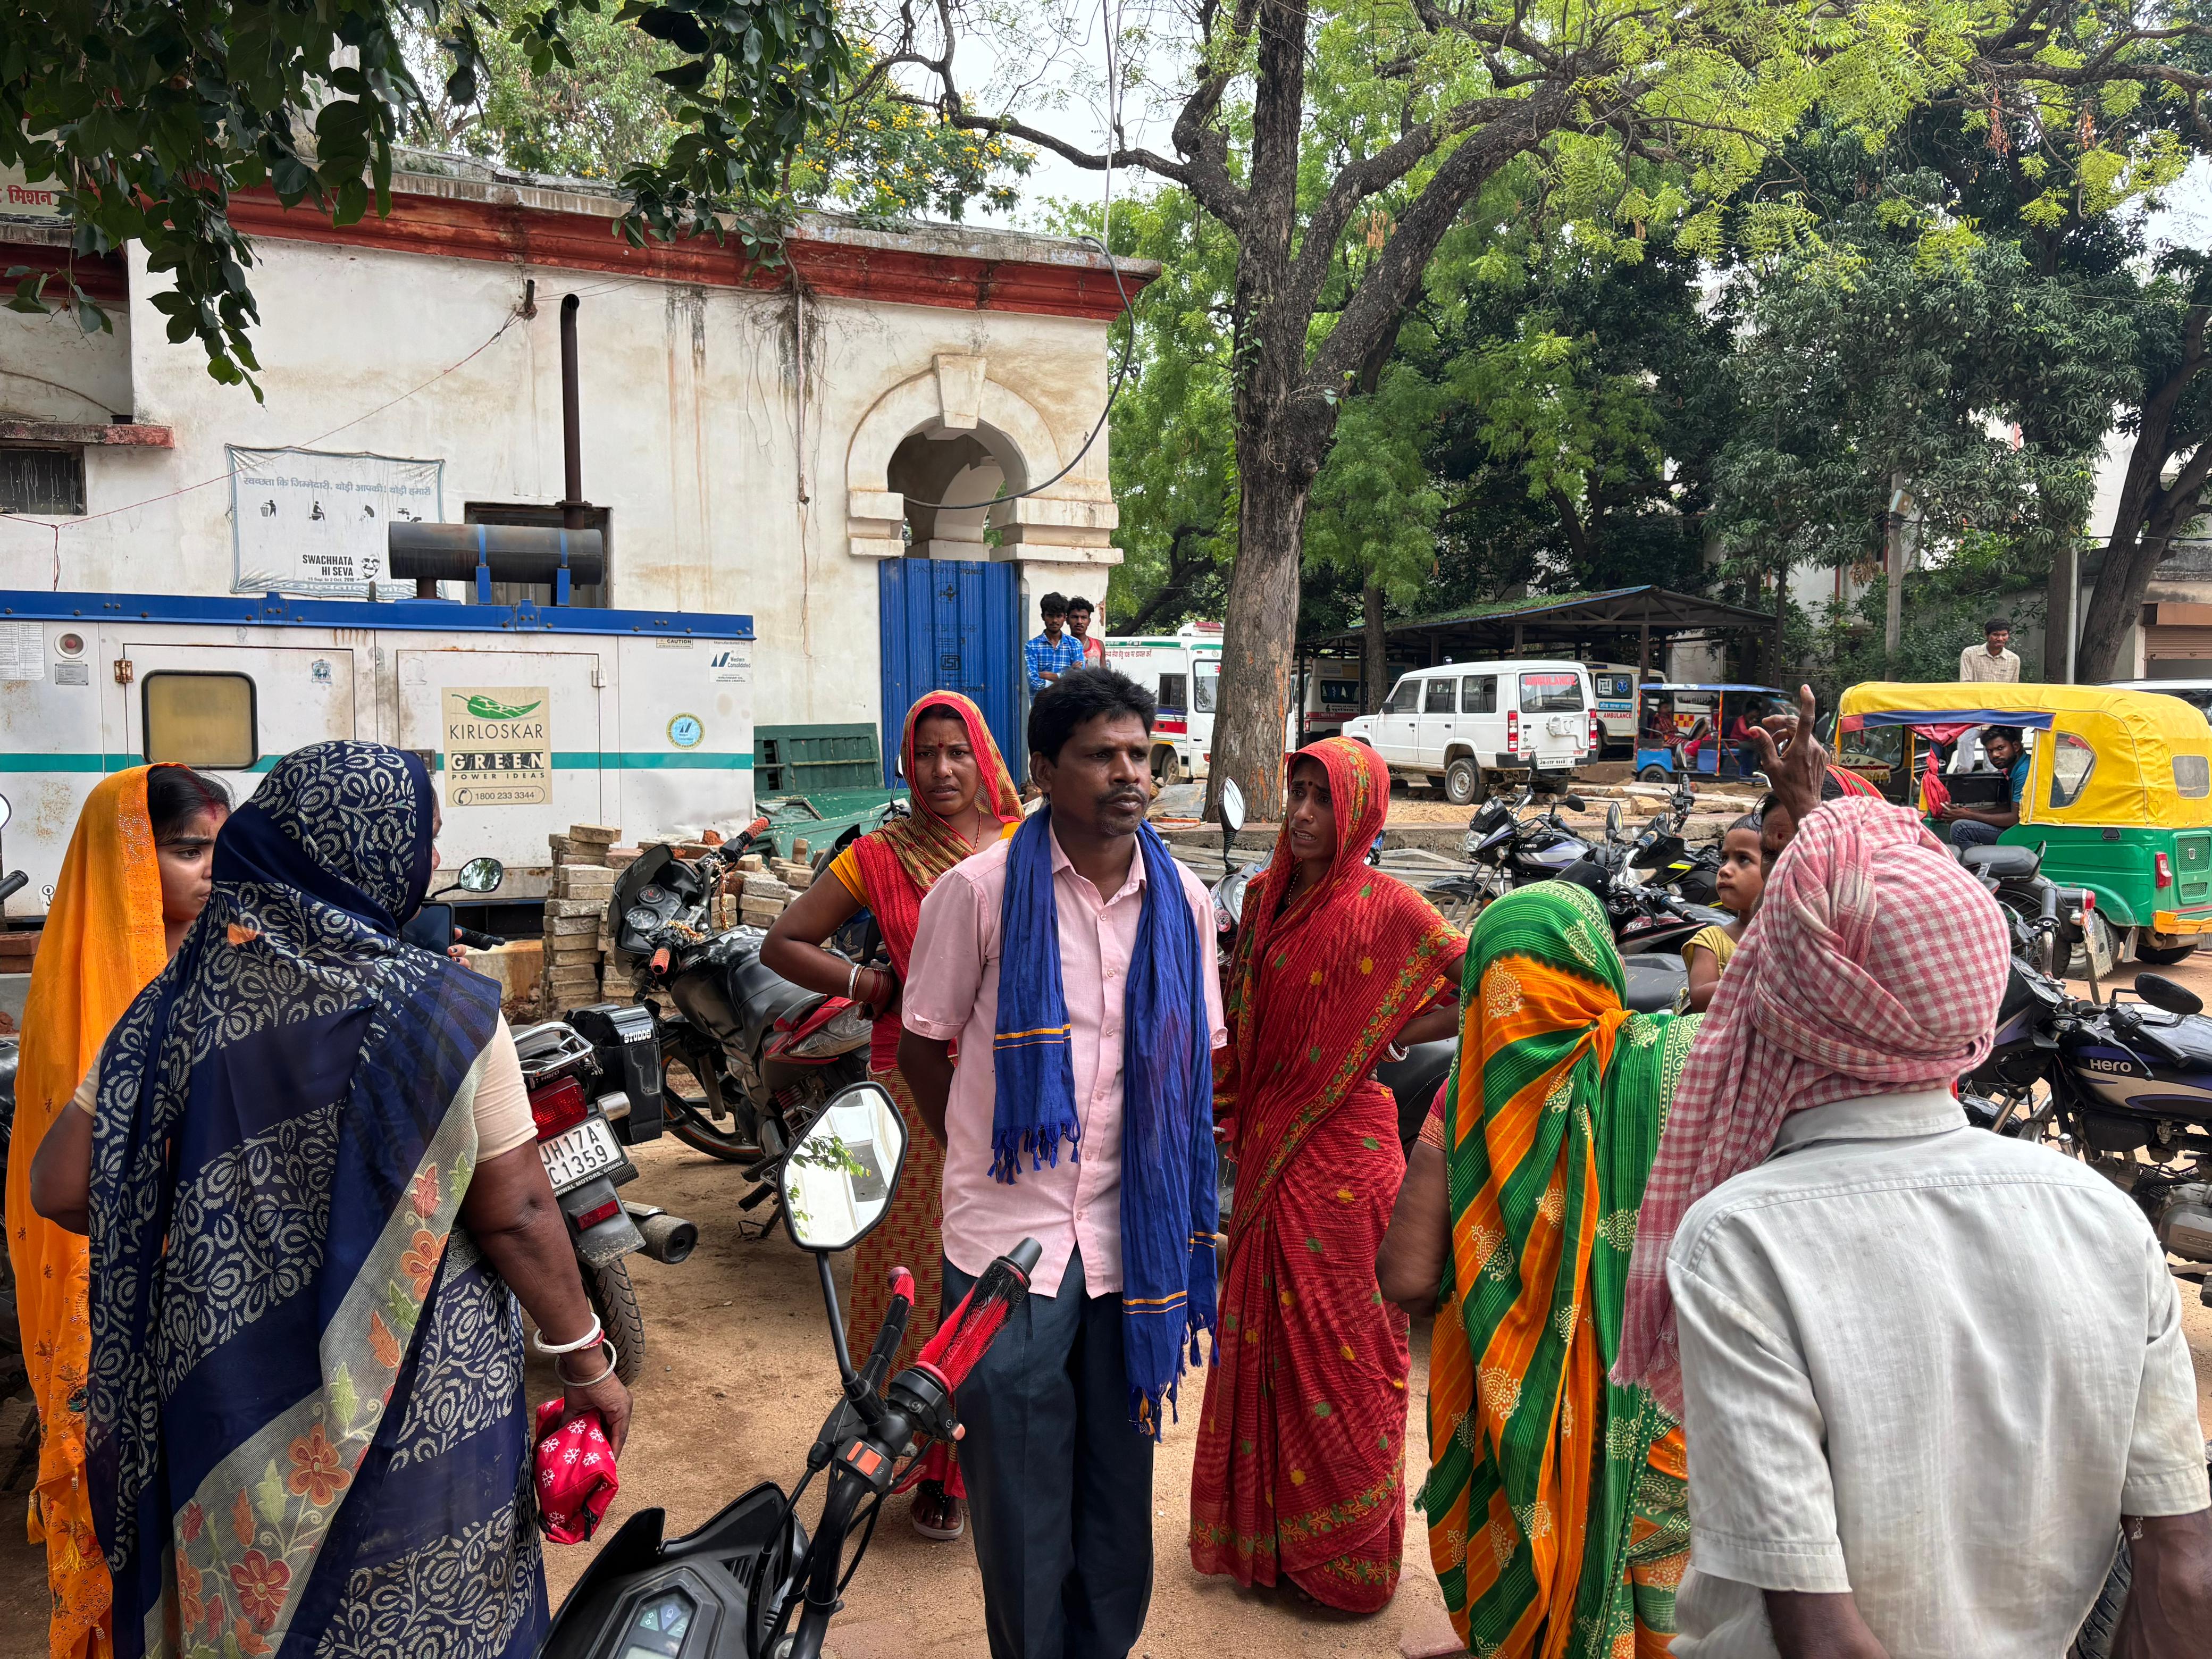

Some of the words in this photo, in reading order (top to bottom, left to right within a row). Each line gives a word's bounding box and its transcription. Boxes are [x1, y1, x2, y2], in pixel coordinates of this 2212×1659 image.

[6, 185, 52, 205] मिशन
[276, 476, 288, 487] कि
[303, 555, 353, 566] SWACHHATA
[322, 566, 330, 576] HI
[333, 567, 354, 576] SEVA
[1525, 675, 1577, 686] AMBULANCE
[450, 724, 543, 739] KIRLOSKAR
[452, 753, 544, 770] GREEN
[624, 1028, 651, 1044] STUDDS
[2090, 1059, 2132, 1073] Hero
[541, 1069, 559, 1082] Hero
[549, 1145, 608, 1185] C1359
[576, 1171, 604, 1186] MOTORS,
[604, 1160, 625, 1174] GODDA
